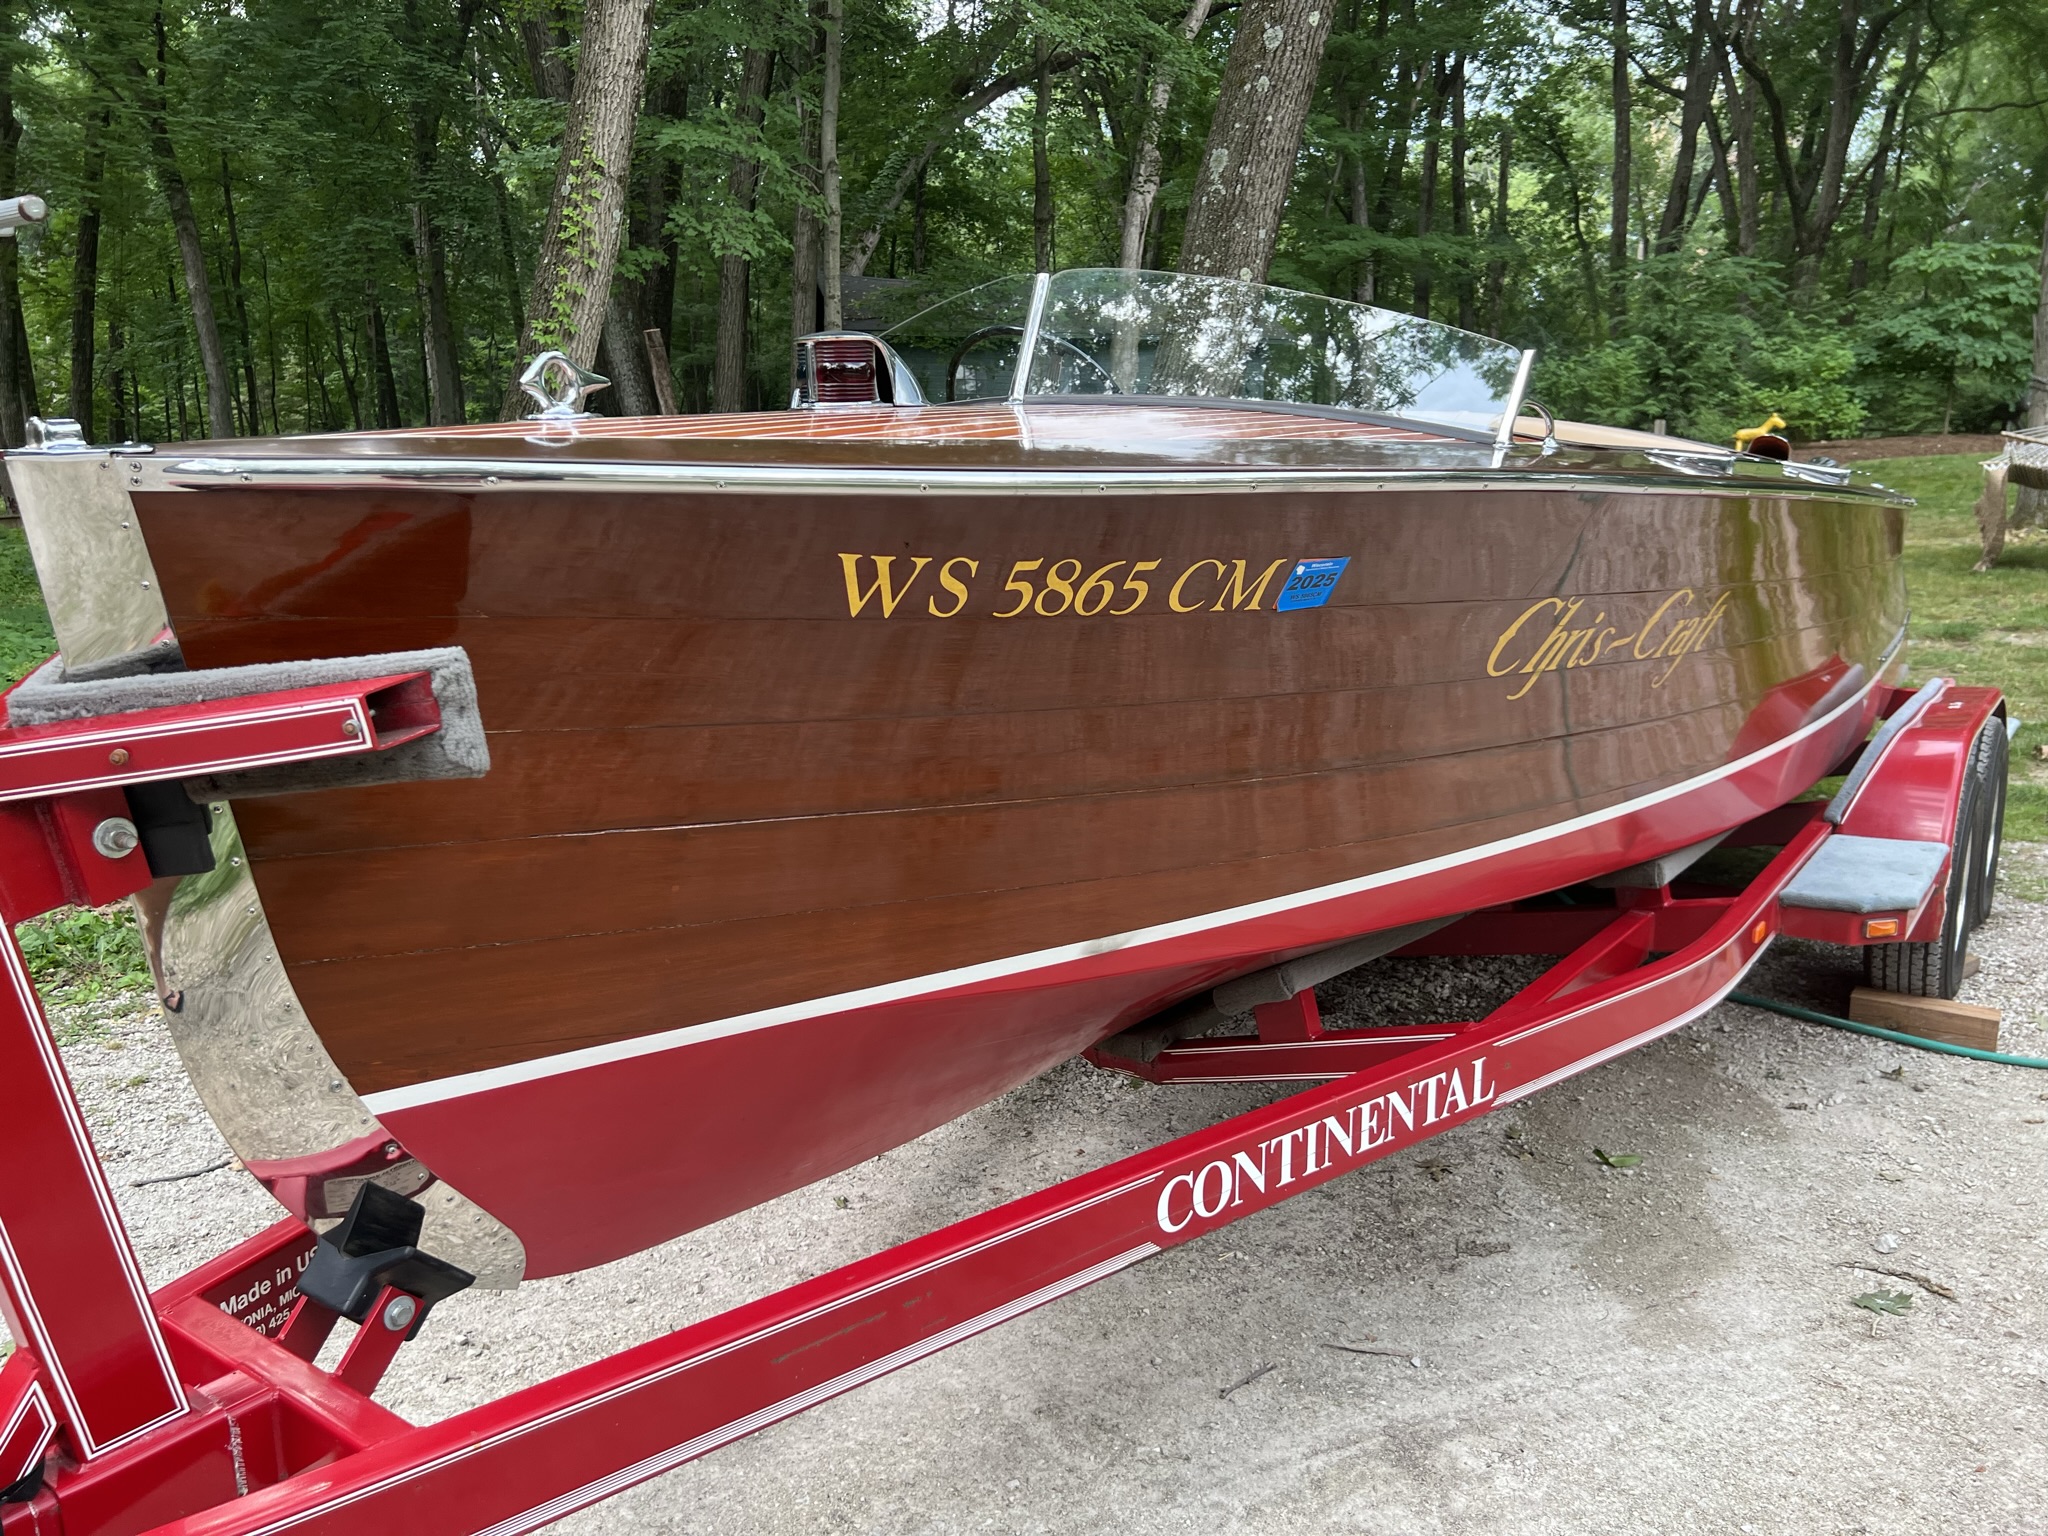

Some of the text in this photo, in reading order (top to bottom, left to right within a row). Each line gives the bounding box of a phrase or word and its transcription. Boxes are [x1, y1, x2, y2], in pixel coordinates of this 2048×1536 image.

[992, 557, 1162, 617] 5865
[1168, 558, 1288, 613] CM
[1287, 572, 1339, 591] 2025
[1486, 589, 1732, 701] Chris-Craft
[1156, 1056, 1496, 1234] CONTINENTAL
[220, 1279, 272, 1316] Made
[275, 1265, 292, 1287] in
[240, 1302, 277, 1328] ONIA,
[268, 1307, 291, 1329] 425
